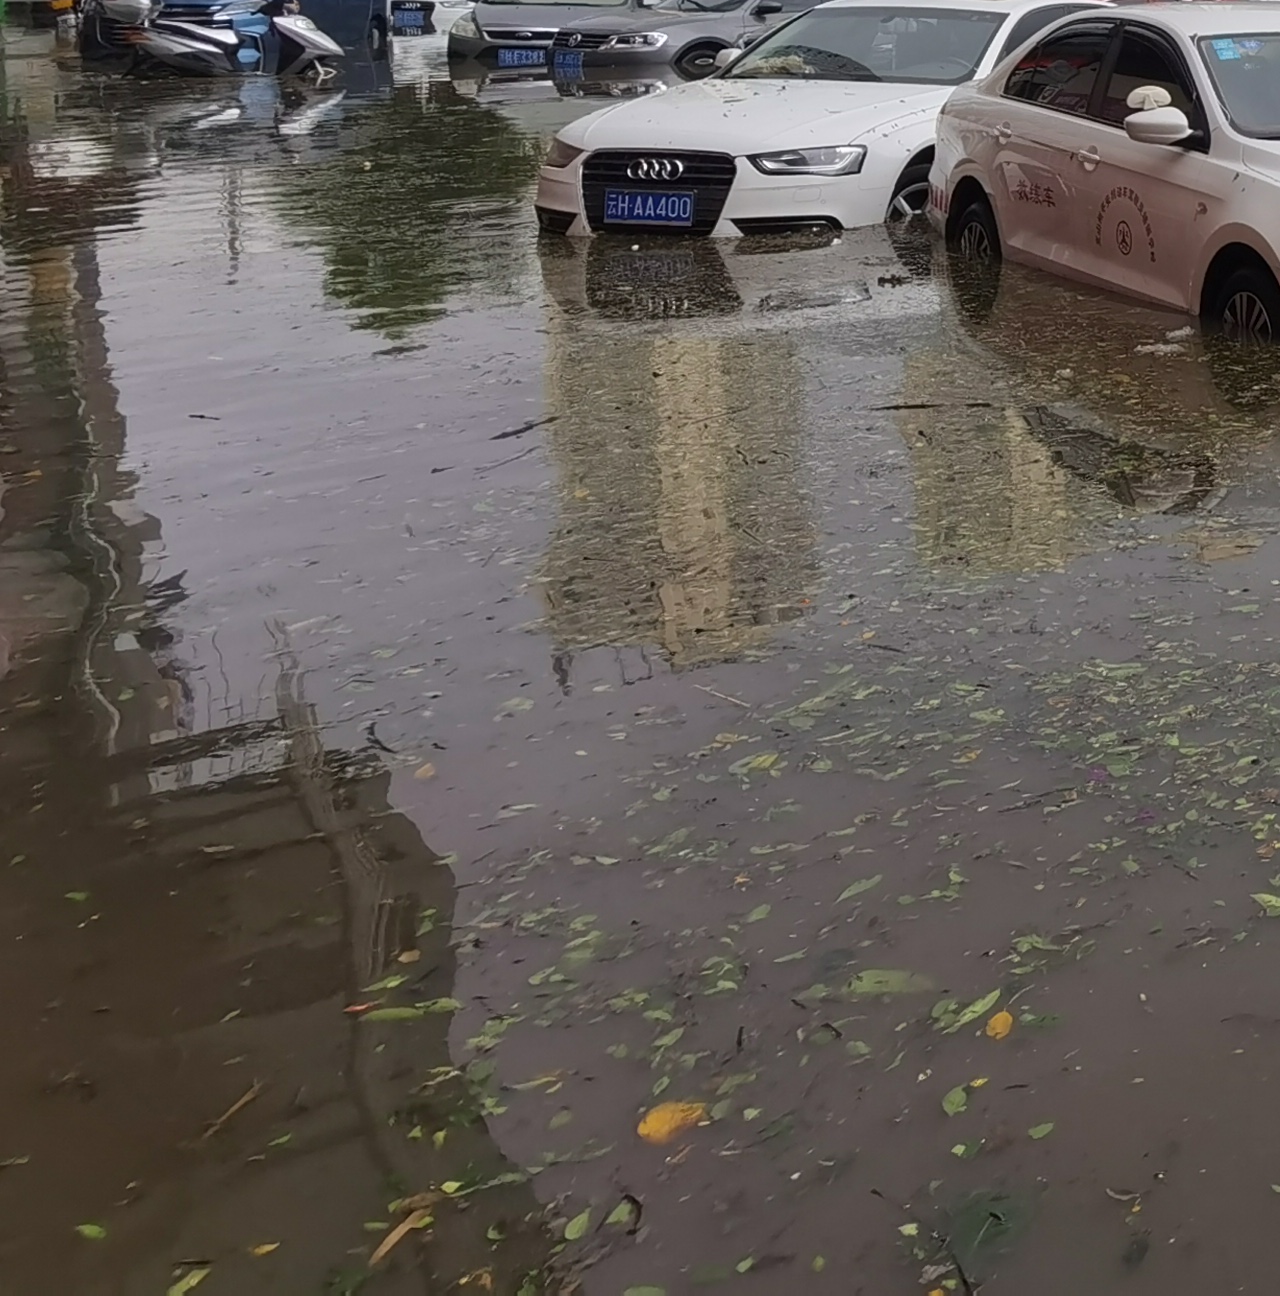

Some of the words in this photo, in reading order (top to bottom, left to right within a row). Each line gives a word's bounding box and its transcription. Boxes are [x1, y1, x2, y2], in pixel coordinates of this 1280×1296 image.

[607, 194, 691, 218] 云H·AA400
[1016, 179, 1057, 208] 教练车
